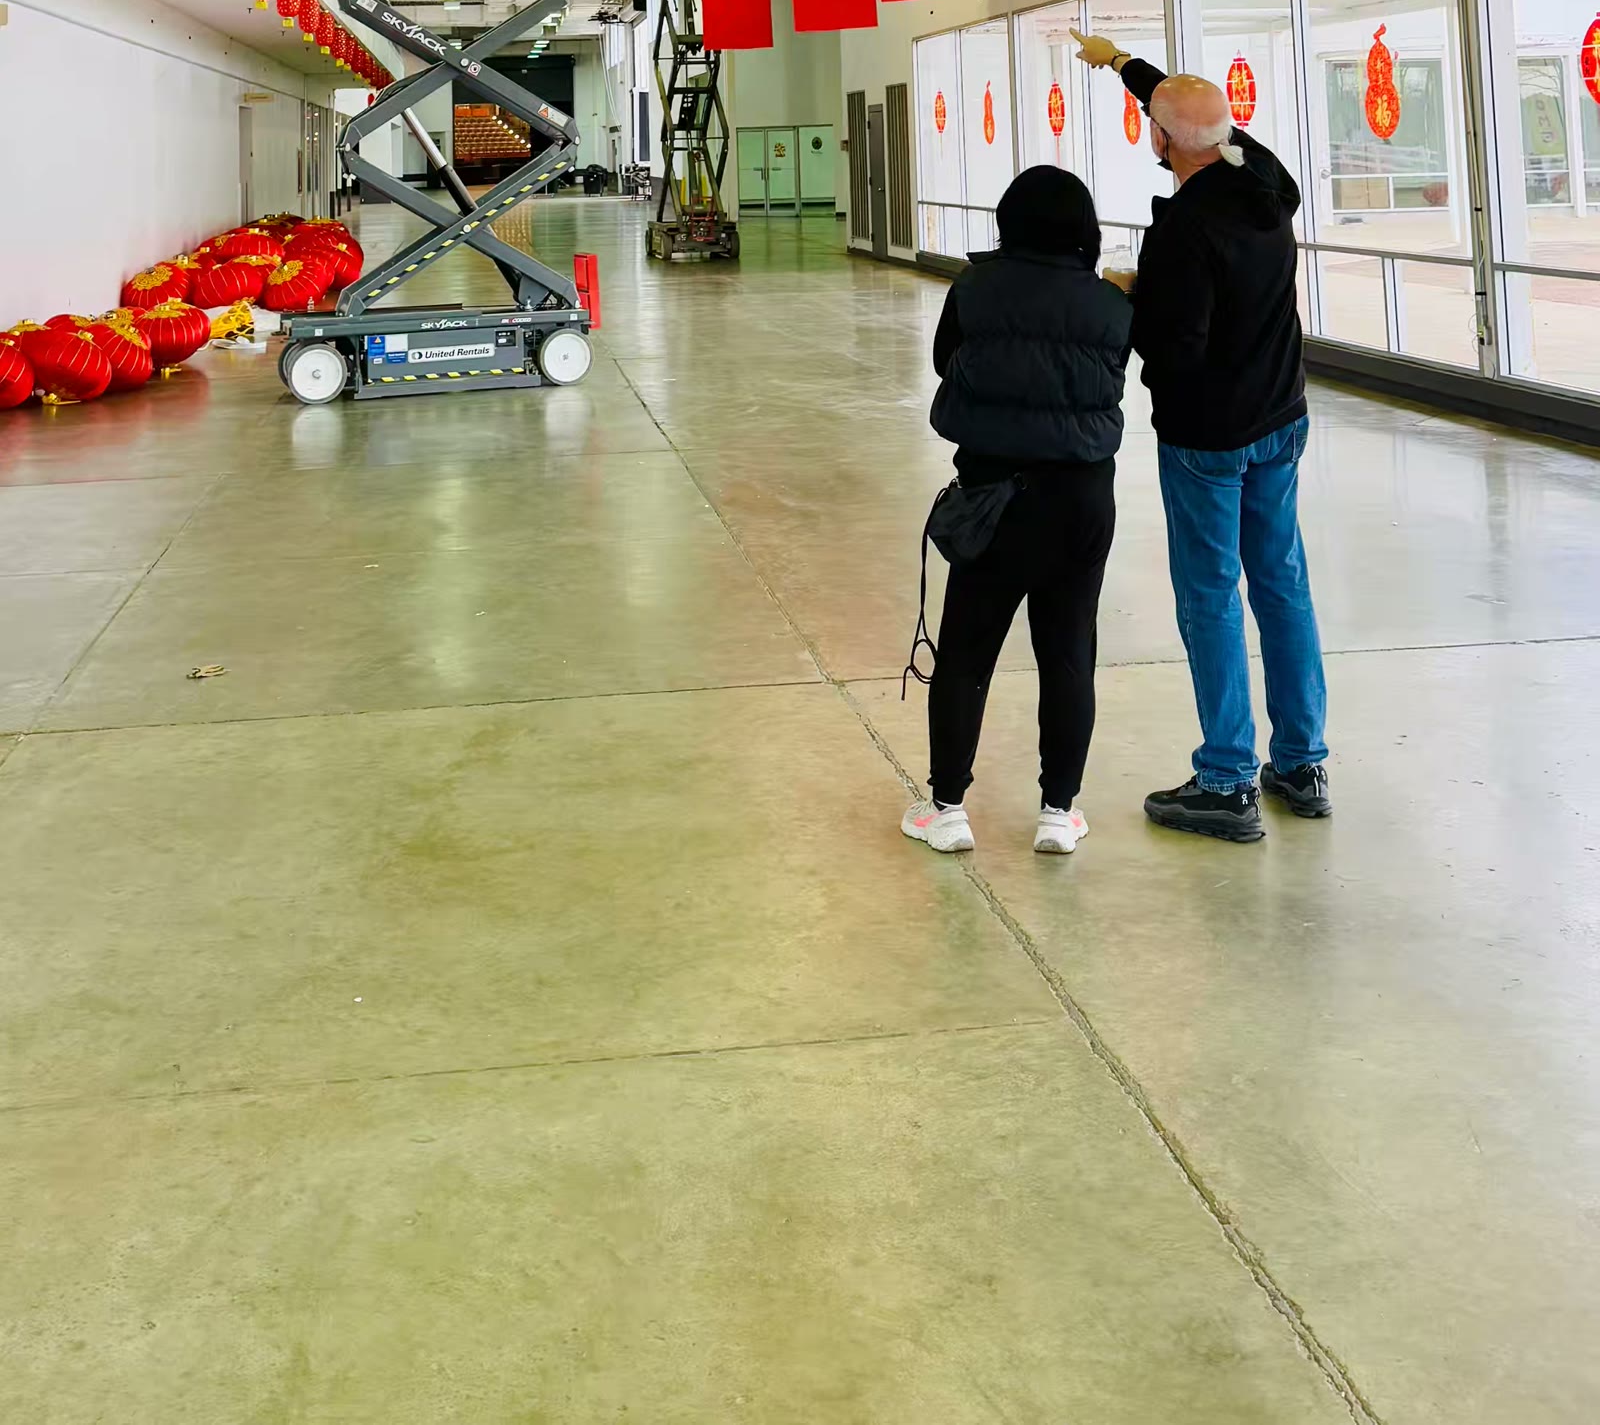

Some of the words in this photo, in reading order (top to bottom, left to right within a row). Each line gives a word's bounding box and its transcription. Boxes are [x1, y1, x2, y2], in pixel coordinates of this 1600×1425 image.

[381, 11, 447, 56] SKYJACK
[421, 318, 468, 330] SKYJACK
[425, 349, 455, 359] United
[457, 346, 490, 356] Rentals
